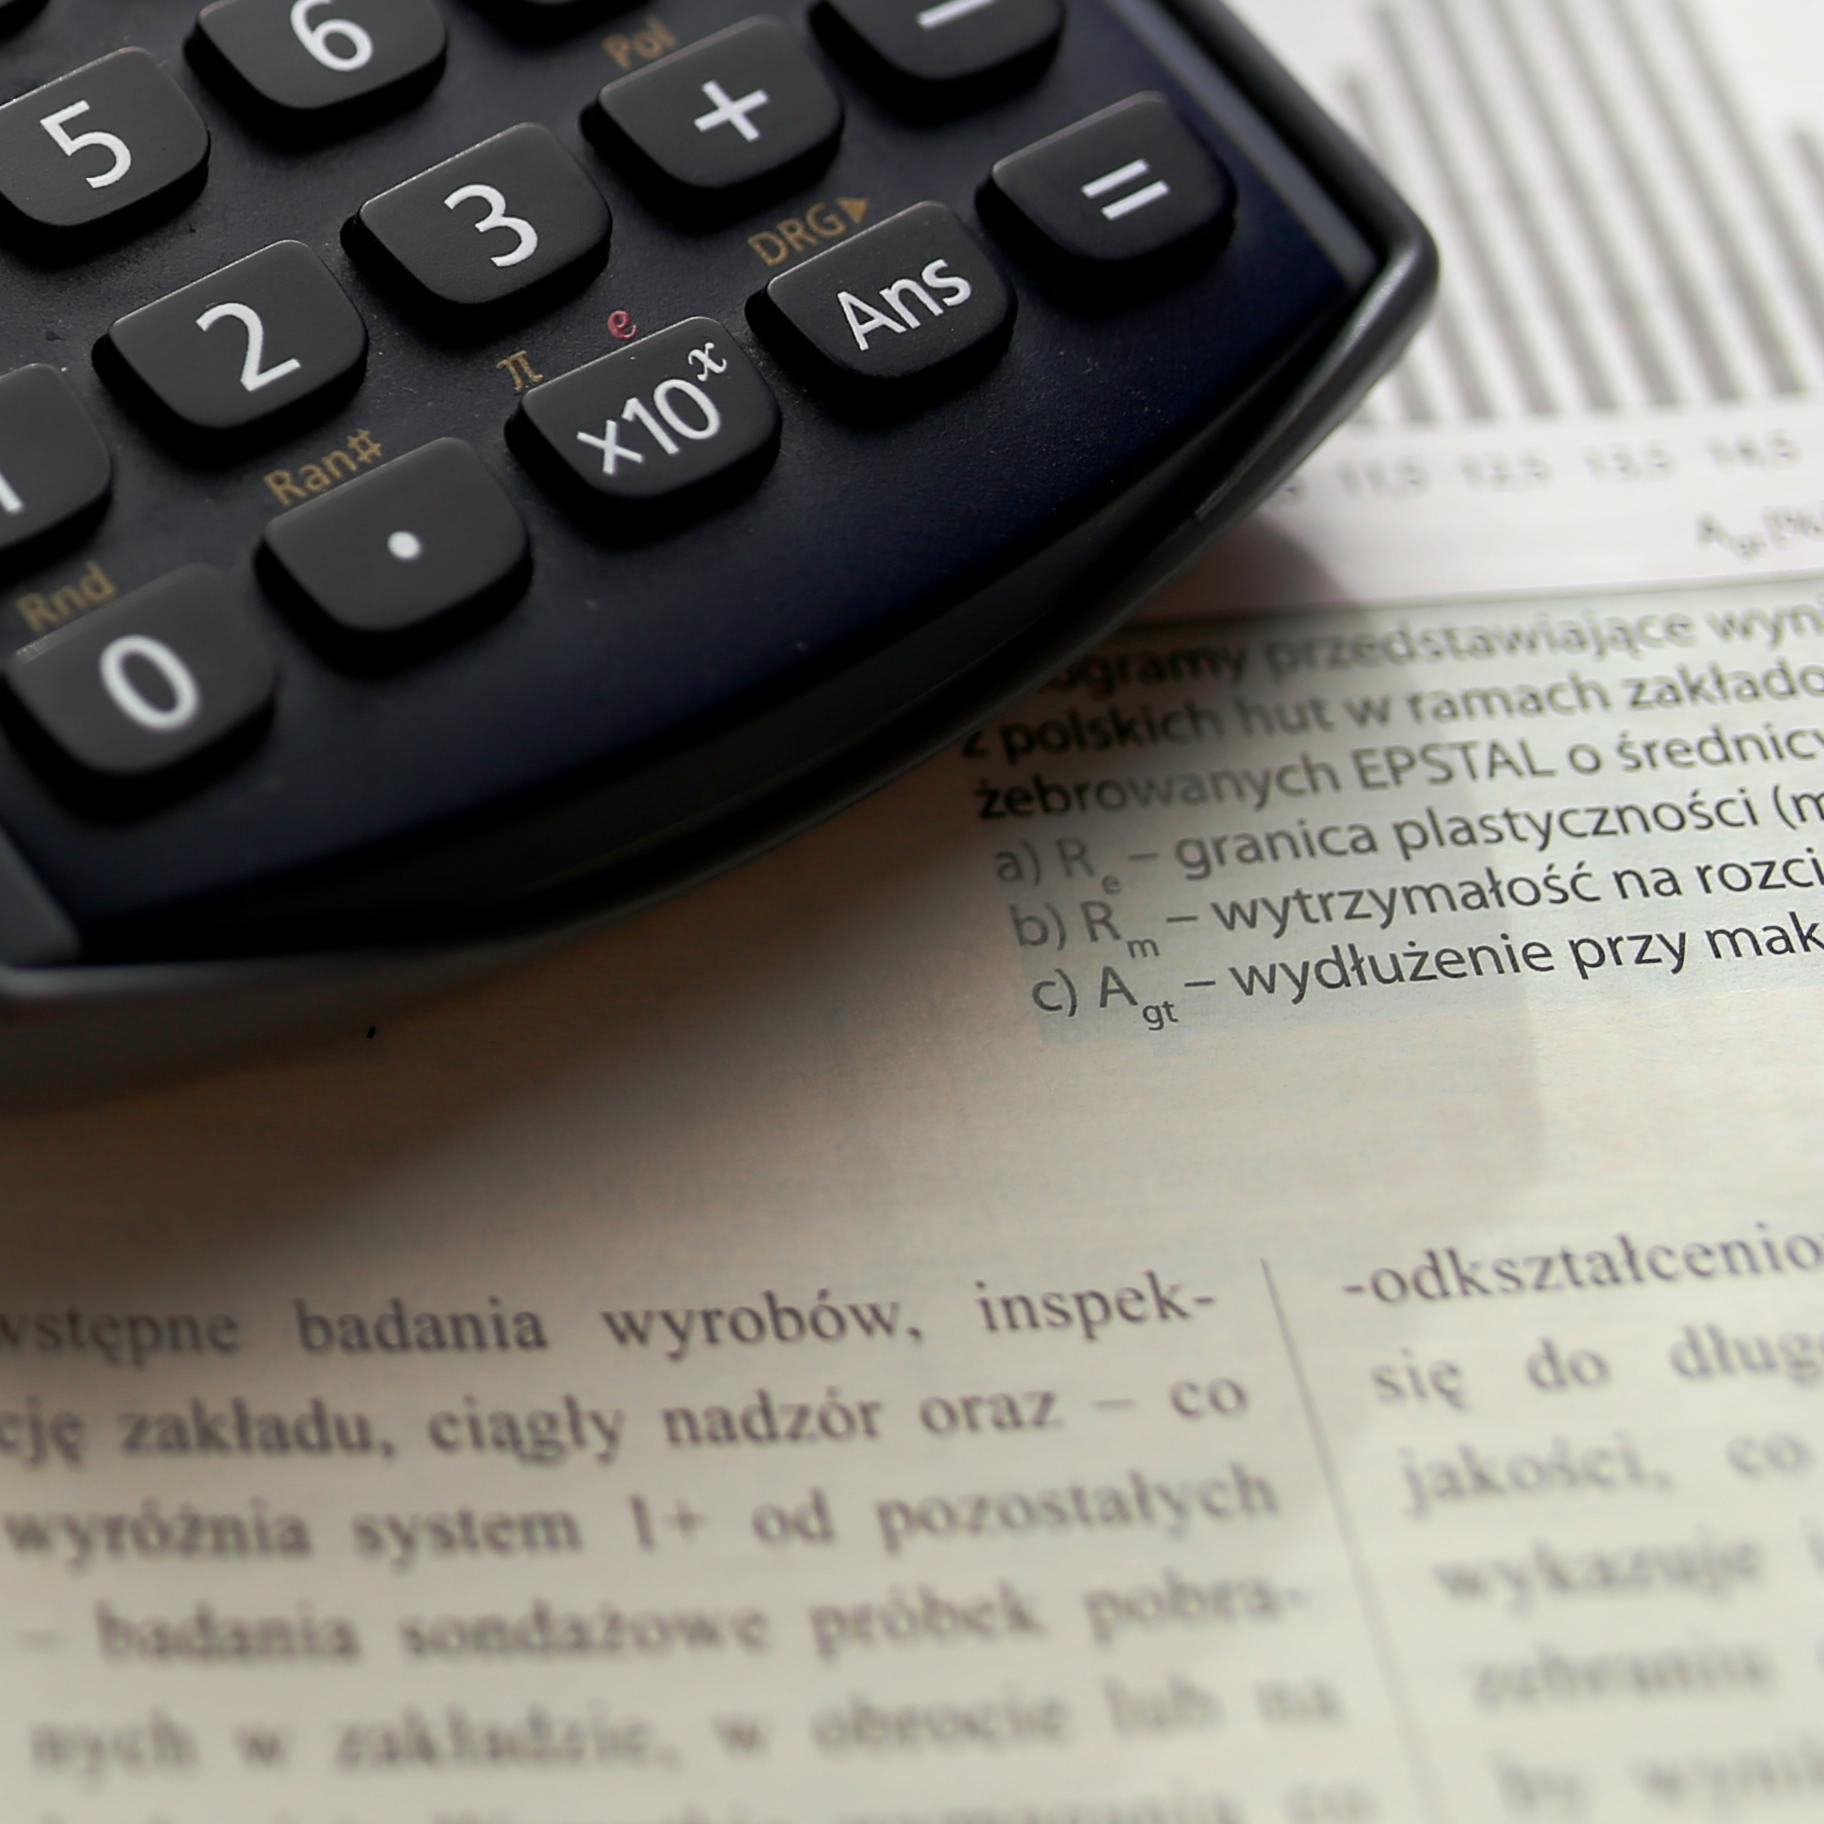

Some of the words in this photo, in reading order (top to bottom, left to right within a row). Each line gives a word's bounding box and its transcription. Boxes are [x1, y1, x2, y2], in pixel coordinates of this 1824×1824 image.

[602, 21, 679, 73] Pol
[39, 99, 133, 190] 5
[443, 183, 540, 267] 3
[196, 302, 302, 393] 2
[607, 310, 638, 342] e
[836, 257, 972, 352] Ans
[263, 427, 385, 506] Ran#
[14, 562, 118, 637] Rnd
[1266, 612, 1697, 676] przedstawiające
[99, 634, 202, 731] 0
[1000, 701, 1223, 765] polskich
[1237, 694, 1333, 735] hut
[1346, 696, 1391, 729] w
[1407, 671, 1612, 724] ramach
[1621, 658, 1824, 711] zakłado
[975, 752, 1340, 821] żebrowanych
[1352, 739, 1556, 791] EPSTAL
[1568, 744, 1603, 775] o
[994, 838, 1041, 885] a)
[1173, 819, 1377, 879] granica
[1393, 787, 1759, 860] plastyczności
[1010, 903, 1067, 952] b)
[1210, 861, 1601, 940] wytrzymałość
[1612, 866, 1681, 900] na
[1695, 847, 1824, 894] rozci
[1032, 969, 1078, 1017] c)
[1229, 934, 1554, 1004] wydłużenie
[1569, 930, 1687, 980] przy
[1705, 912, 1824, 960] mak
[1344, 1220, 1824, 1305] -odkształcenio
[293, 1296, 548, 1355] badania
[600, 1288, 924, 1364] wyrobów,
[975, 1269, 1215, 1342] inspek-
[1370, 1346, 1467, 1411] się
[1525, 1336, 1612, 1393] do
[119, 1395, 399, 1461] zakładu,
[425, 1393, 626, 1469] ciągły
[662, 1386, 886, 1447] nadzór
[919, 1388, 1059, 1437] oraz
[1169, 1376, 1249, 1418] co
[0, 1496, 313, 1577] wyróżnia
[352, 1504, 585, 1577] system
[751, 1487, 836, 1547] od
[874, 1461, 1282, 1560] pozostałych
[1397, 1426, 1677, 1522] jakości,
[1724, 1431, 1815, 1481] co
[94, 1596, 362, 1664] badania
[399, 1596, 769, 1661] sondażowe
[807, 1581, 1047, 1662] próbek
[1082, 1569, 1308, 1648] pobra-
